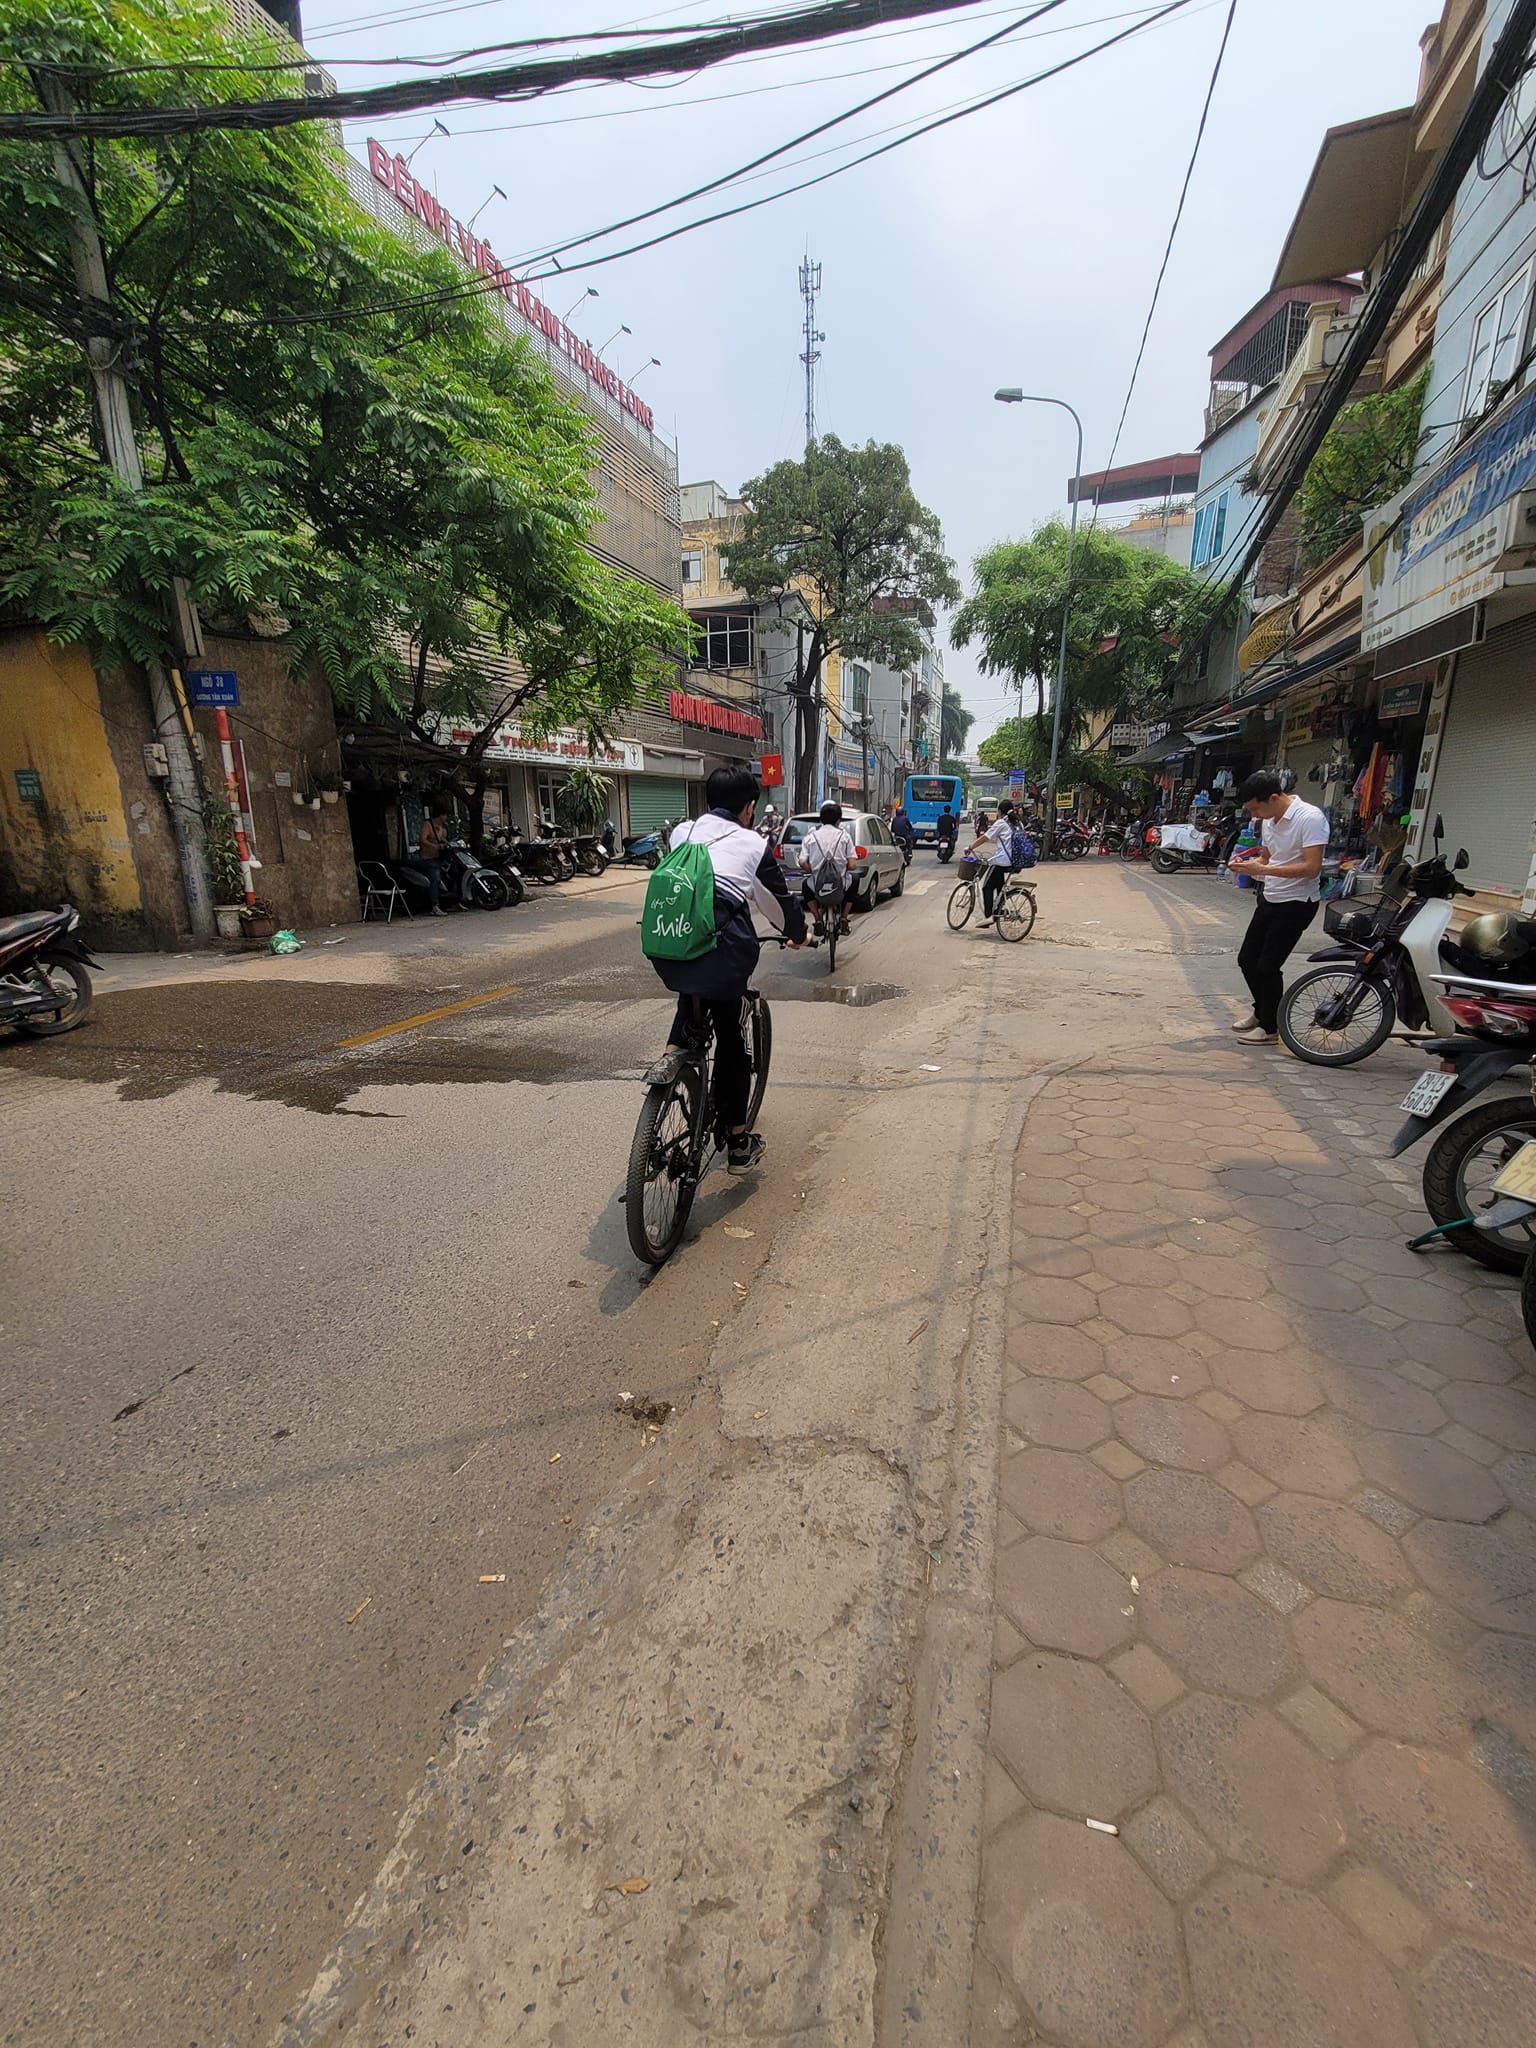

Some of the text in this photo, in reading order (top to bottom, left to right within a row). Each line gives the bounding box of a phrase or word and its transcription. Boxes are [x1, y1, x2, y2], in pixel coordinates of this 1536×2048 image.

[367, 137, 451, 248] BỆNH
[516, 281, 561, 346] NAM
[618, 380, 654, 431] LONG
[652, 912, 693, 937] Smile
